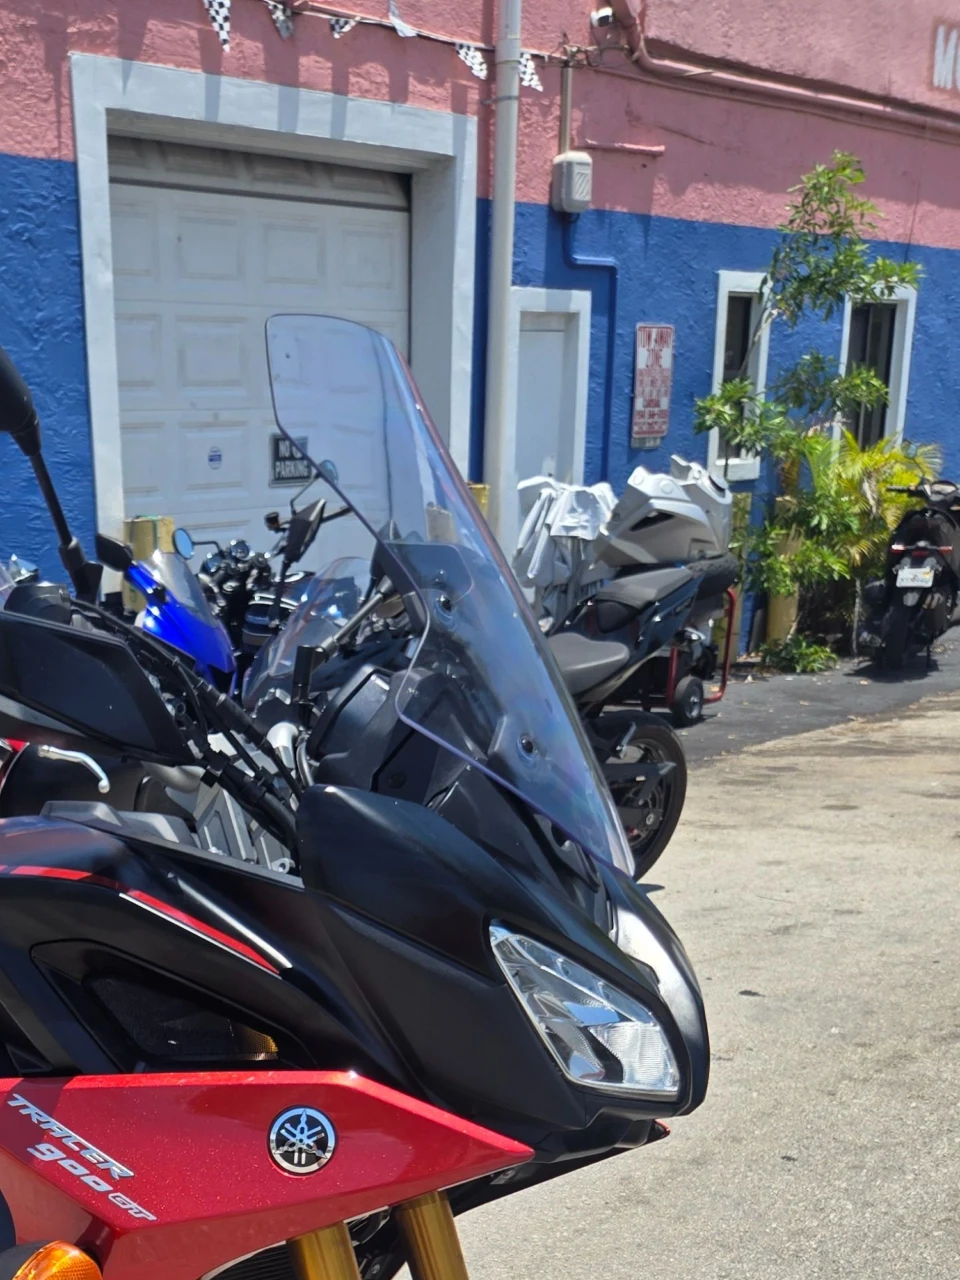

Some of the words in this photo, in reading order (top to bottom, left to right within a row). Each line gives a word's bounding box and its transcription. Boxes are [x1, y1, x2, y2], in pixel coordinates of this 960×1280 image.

[275, 460, 309, 479] PARKING
[278, 440, 290, 458] NO
[6, 1093, 135, 1180] TRACER
[26, 1143, 114, 1192] 900
[108, 1192, 158, 1221] GT
